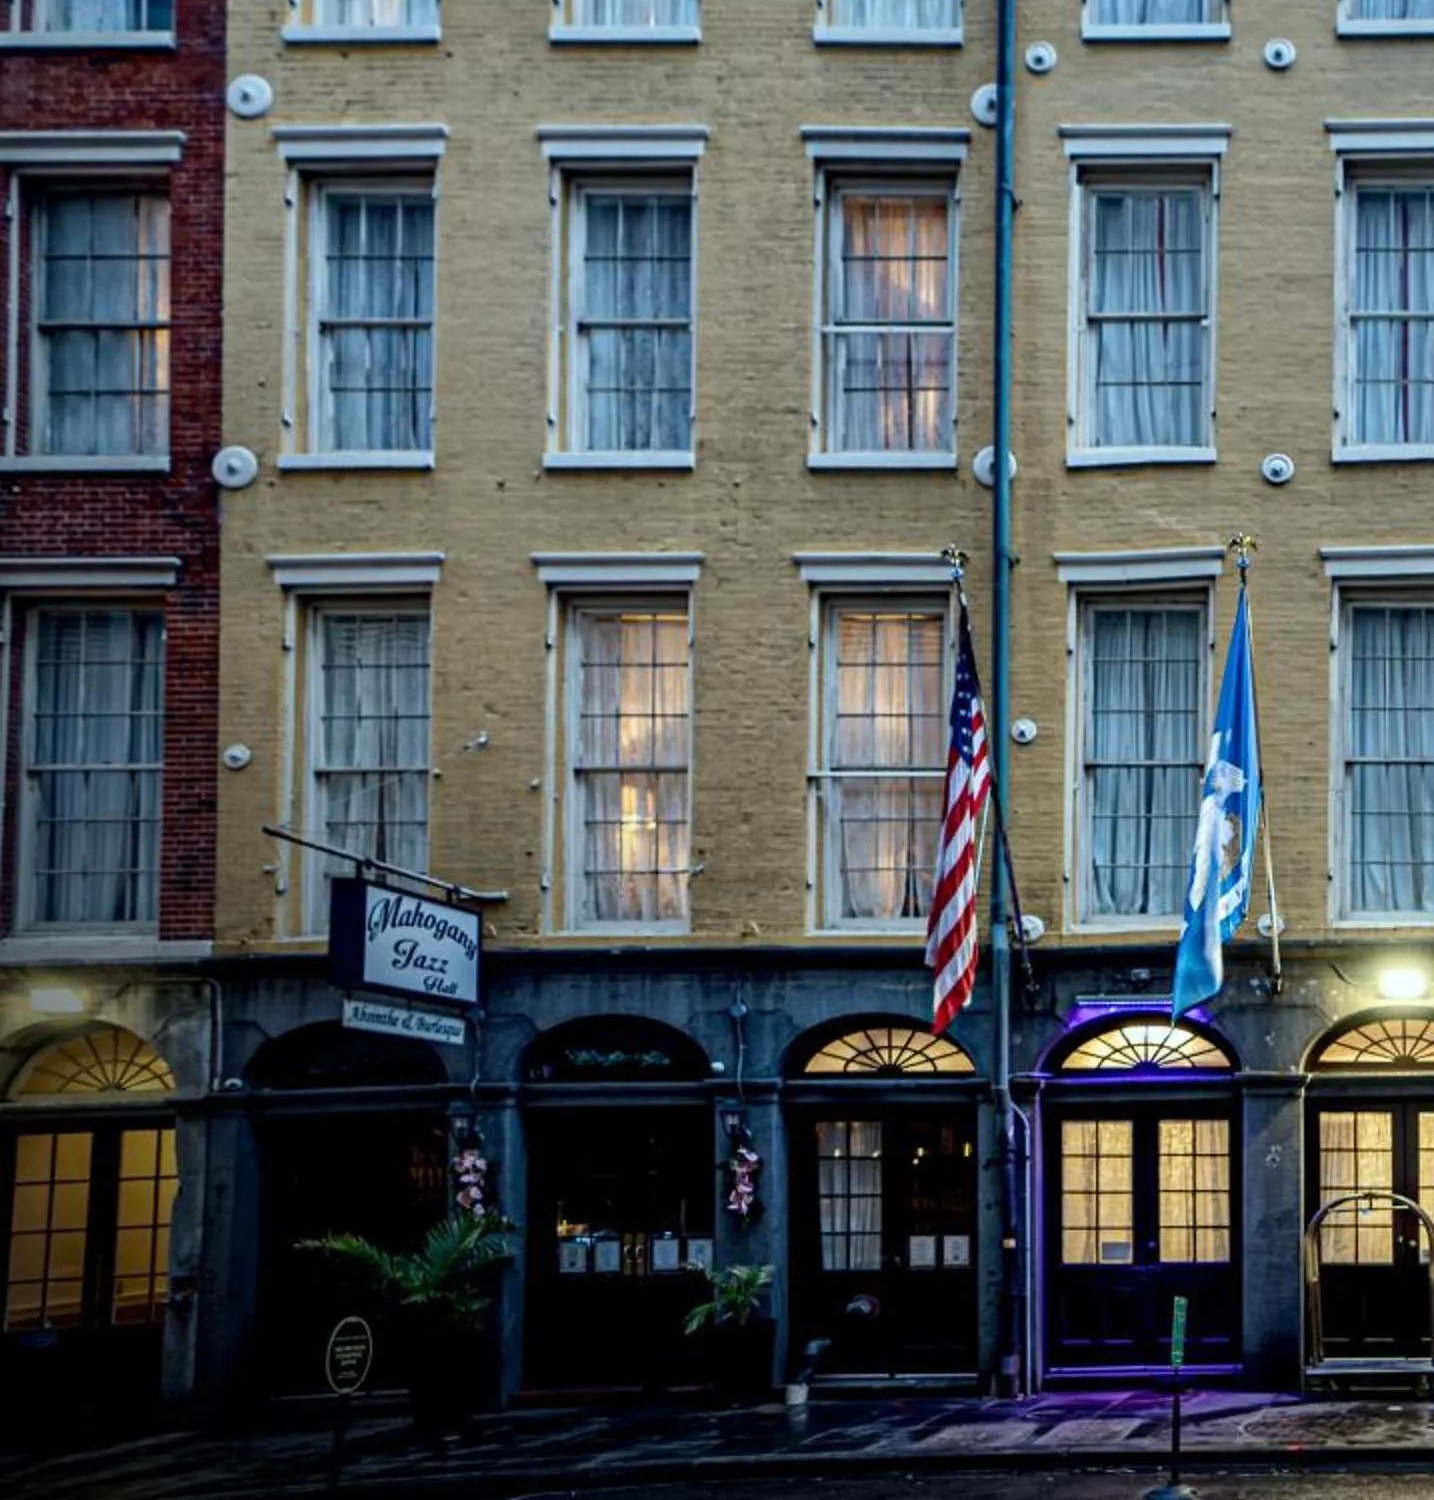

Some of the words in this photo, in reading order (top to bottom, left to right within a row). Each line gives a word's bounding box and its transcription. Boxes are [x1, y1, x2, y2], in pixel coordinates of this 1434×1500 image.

[367, 895, 478, 961] Mahogany
[391, 938, 449, 974] Jazz
[423, 976, 458, 995] Hall
